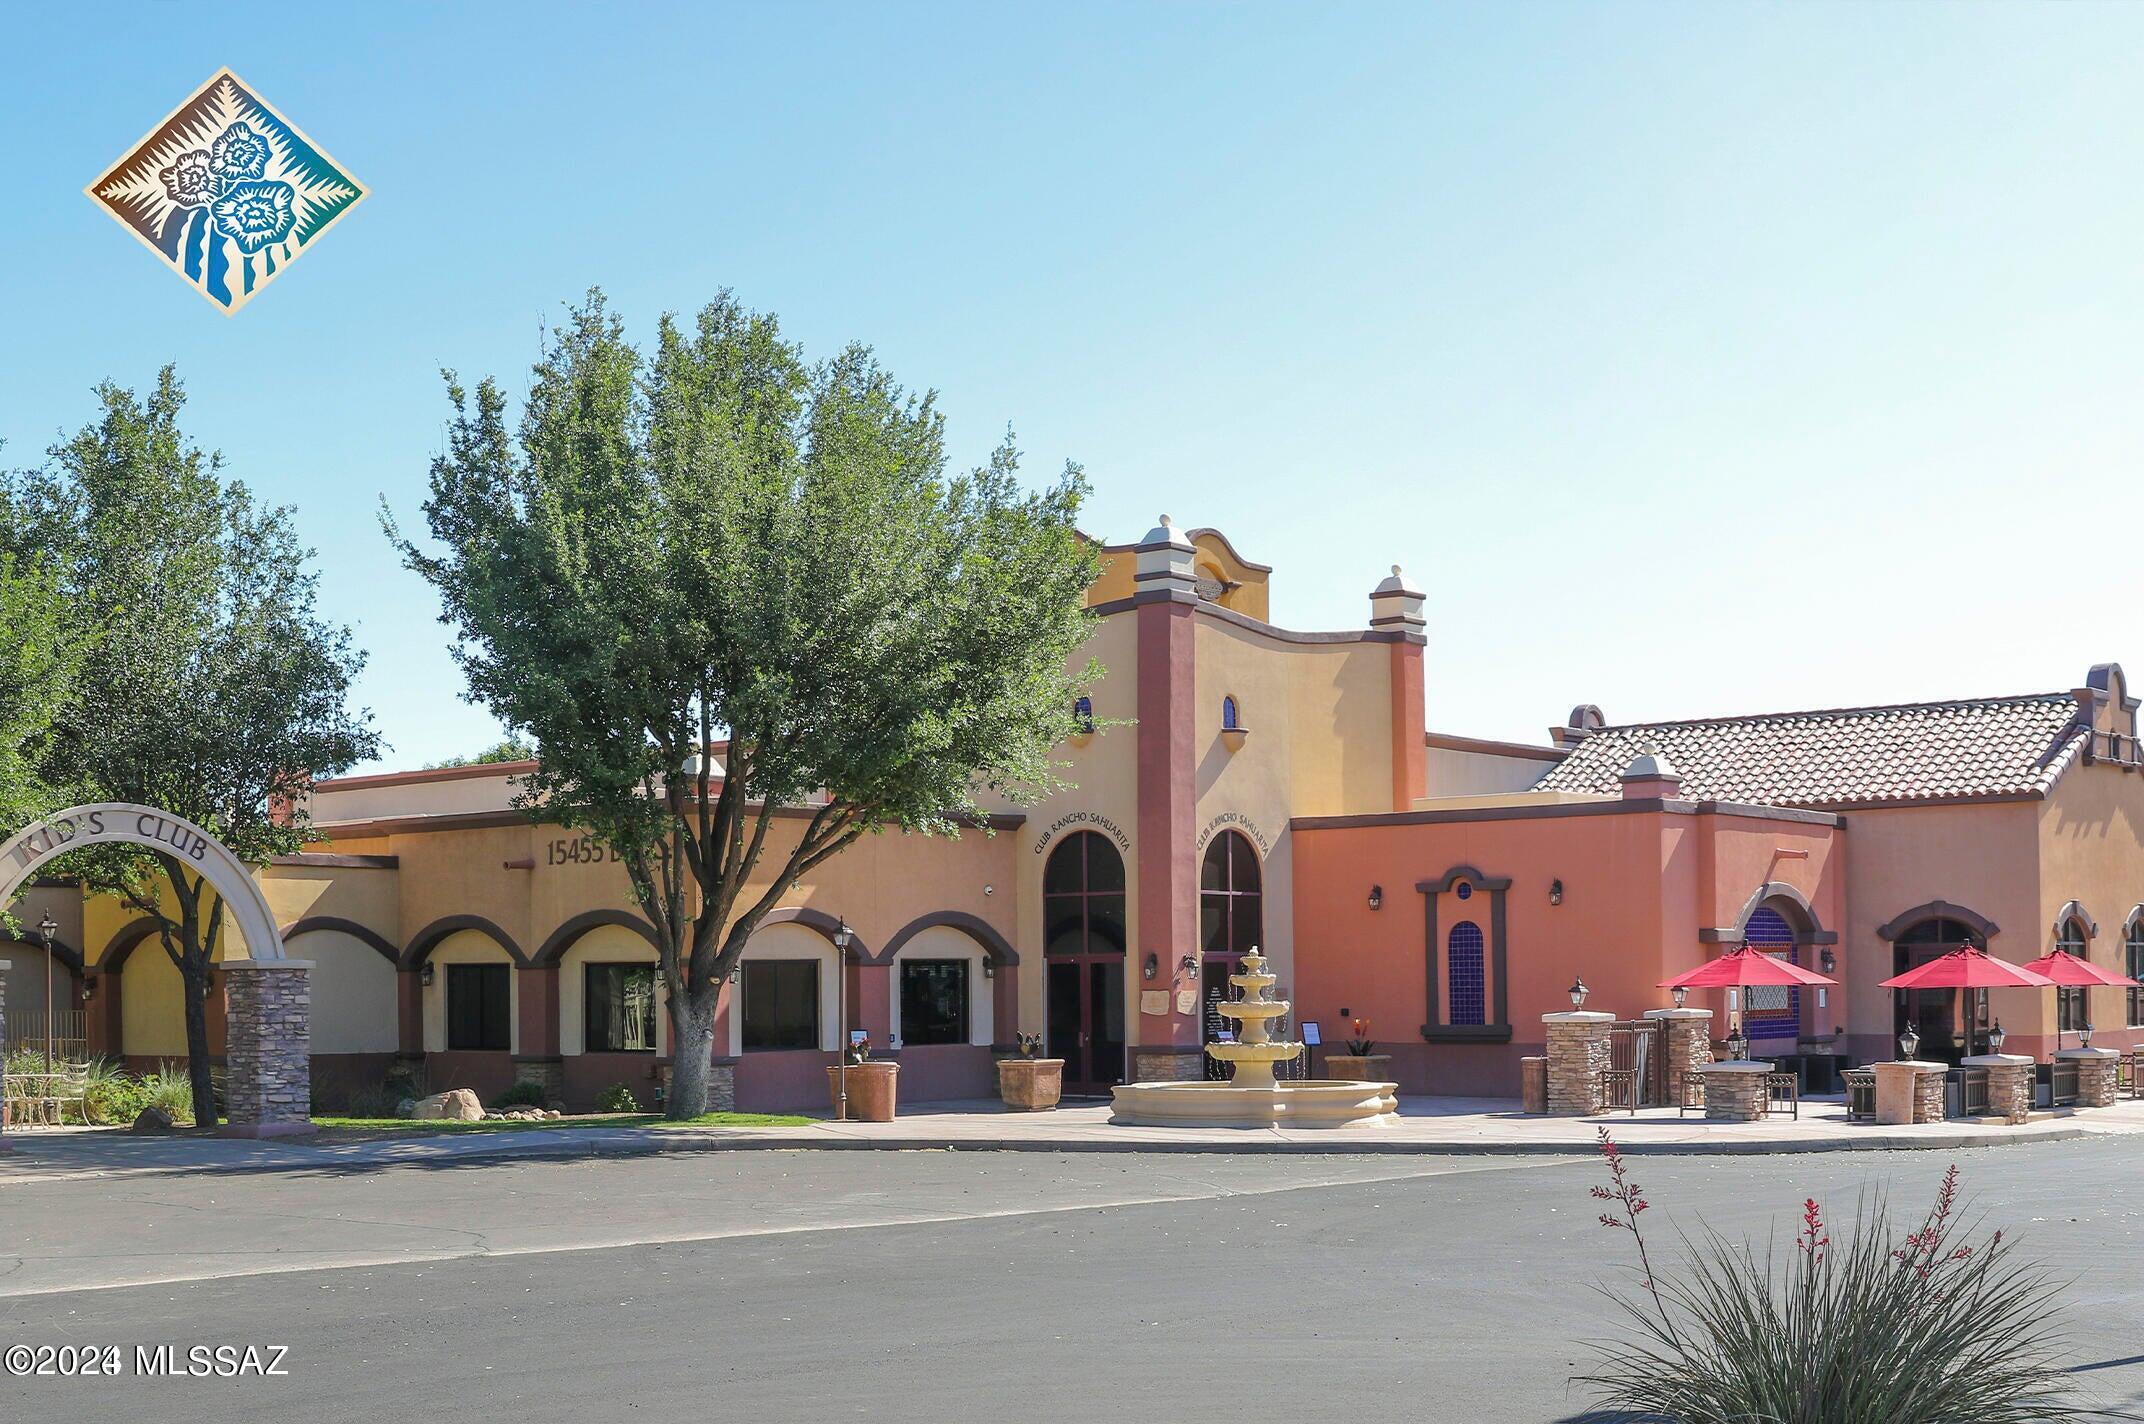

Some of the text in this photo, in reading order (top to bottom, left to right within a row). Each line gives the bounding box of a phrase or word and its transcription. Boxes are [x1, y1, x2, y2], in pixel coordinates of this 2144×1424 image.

[17, 811, 207, 864] KID'S CLUB
[547, 837, 604, 866] 15455
[1034, 812, 1130, 854] CLUB RANCHO SAHUARITA
